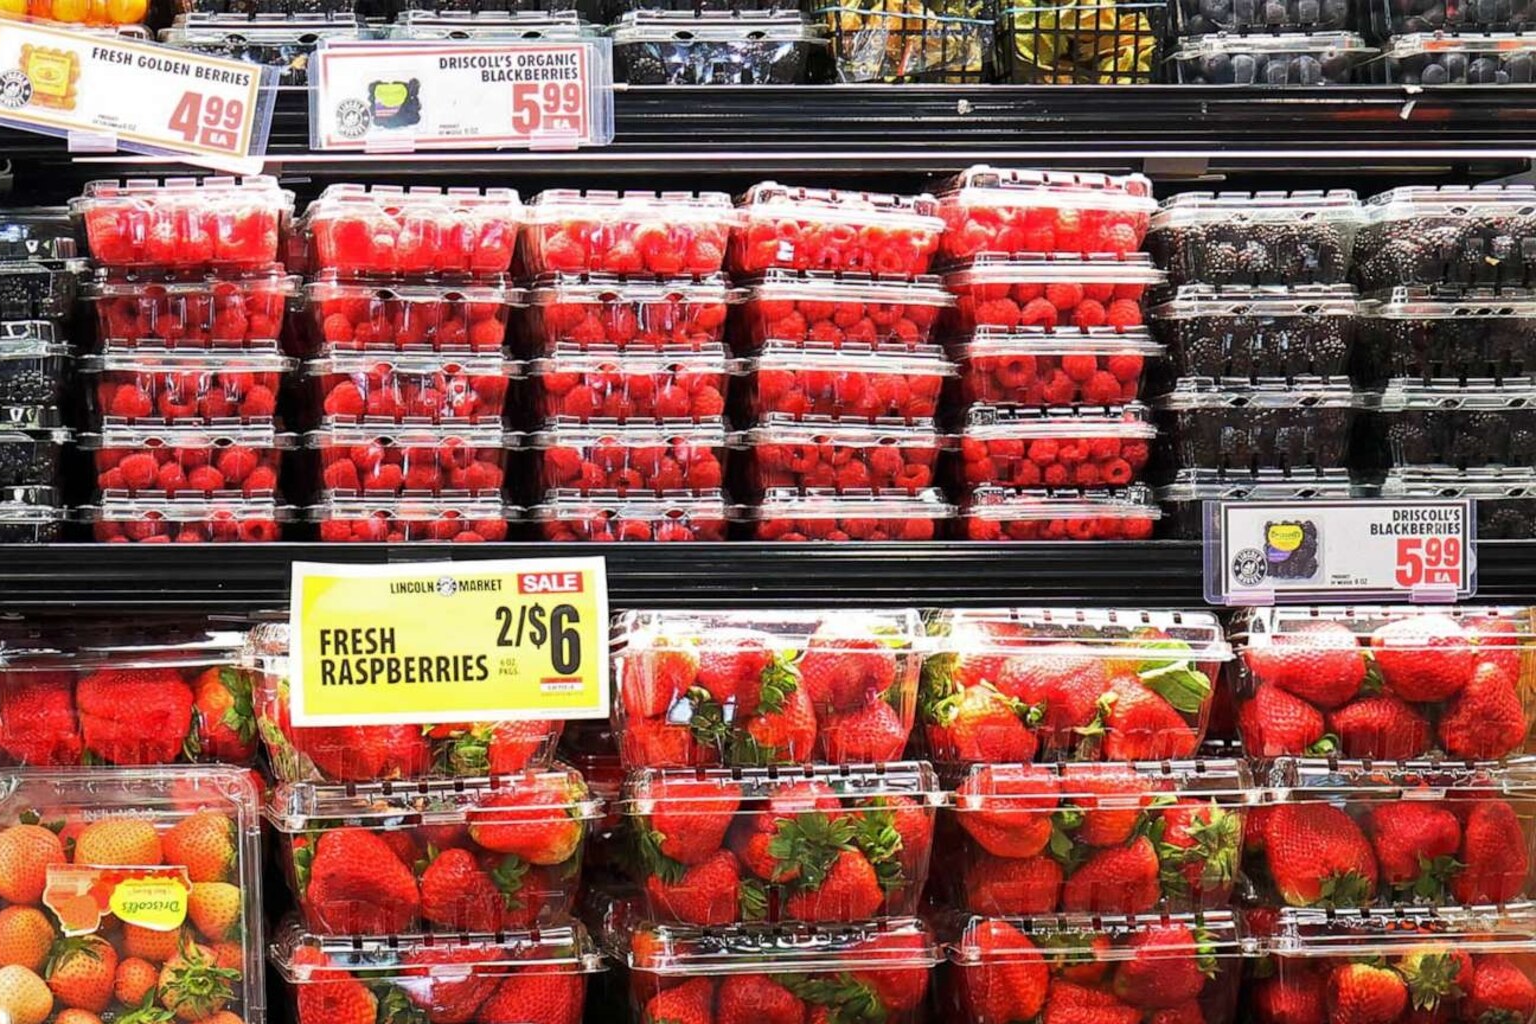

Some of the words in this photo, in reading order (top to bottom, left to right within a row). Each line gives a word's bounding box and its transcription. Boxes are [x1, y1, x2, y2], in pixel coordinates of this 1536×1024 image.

[91, 47, 133, 66] FRESH
[138, 55, 190, 76] GOLDEN
[195, 65, 251, 87] BERRIES
[439, 55, 513, 70] DRISCOLL'S
[517, 53, 577, 68] ORGANIC
[481, 67, 579, 83] BLACKBERRIES
[1392, 509, 1460, 522] DRISCOLL'S
[1370, 522, 1461, 536] BLACKBERRIES
[390, 581, 435, 595] LINCOLN
[458, 579, 502, 592] MARKET
[522, 574, 579, 593] SALE
[319, 627, 396, 656] FRESH
[321, 654, 489, 686] RASPBERRIES
